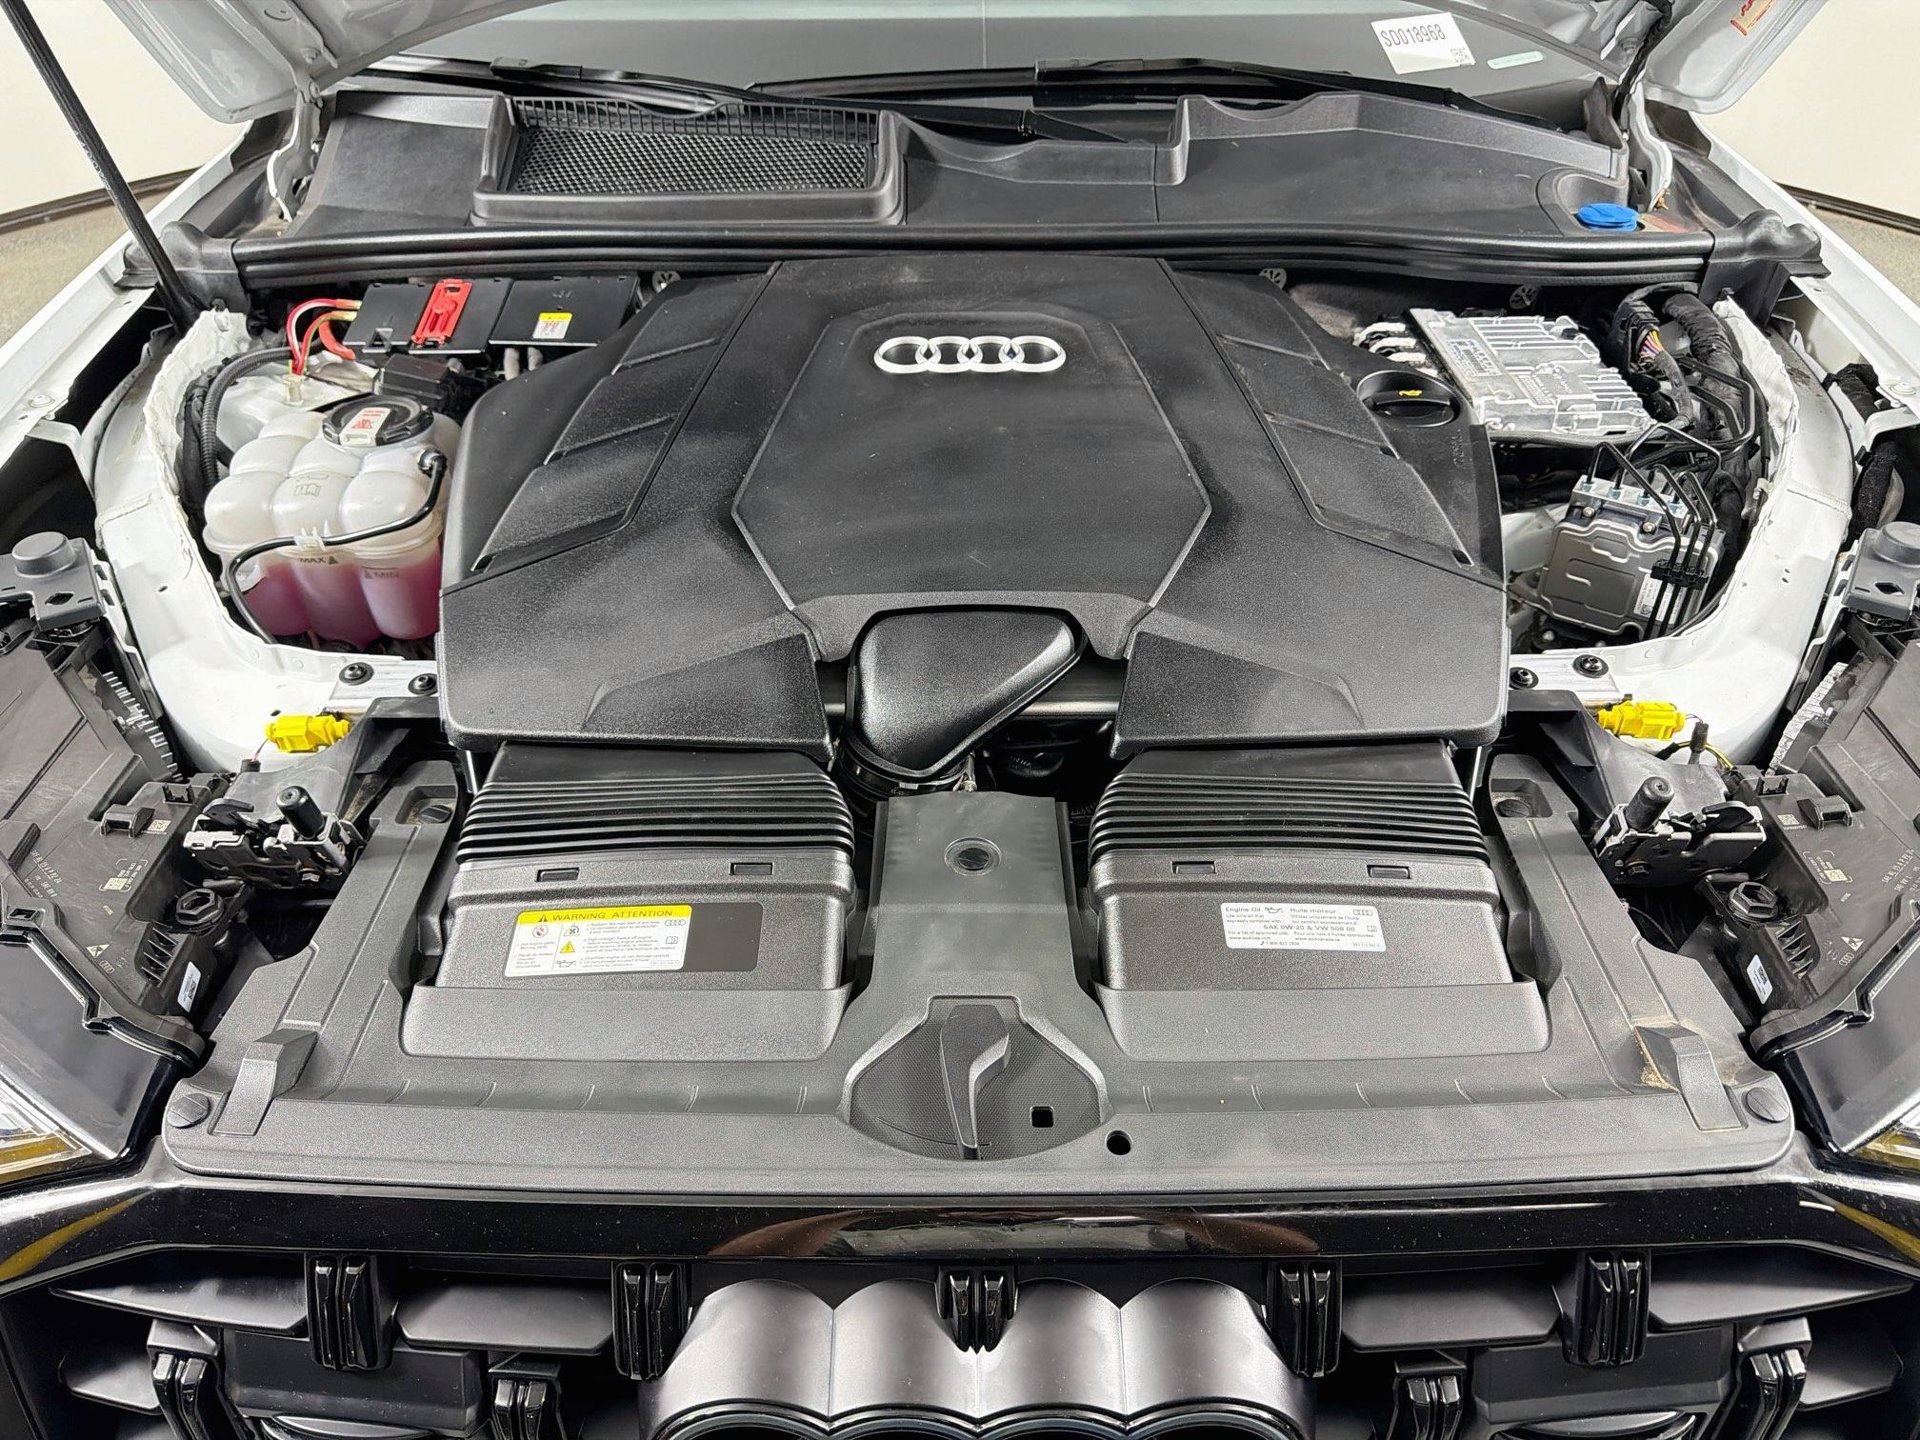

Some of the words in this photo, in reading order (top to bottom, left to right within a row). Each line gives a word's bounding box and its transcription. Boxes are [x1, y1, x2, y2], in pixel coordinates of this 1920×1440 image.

[1380, 23, 1446, 47] SD018968
[300, 556, 326, 564] MAX
[552, 912, 606, 921] WARNING
[611, 909, 673, 918] ATTENTION
